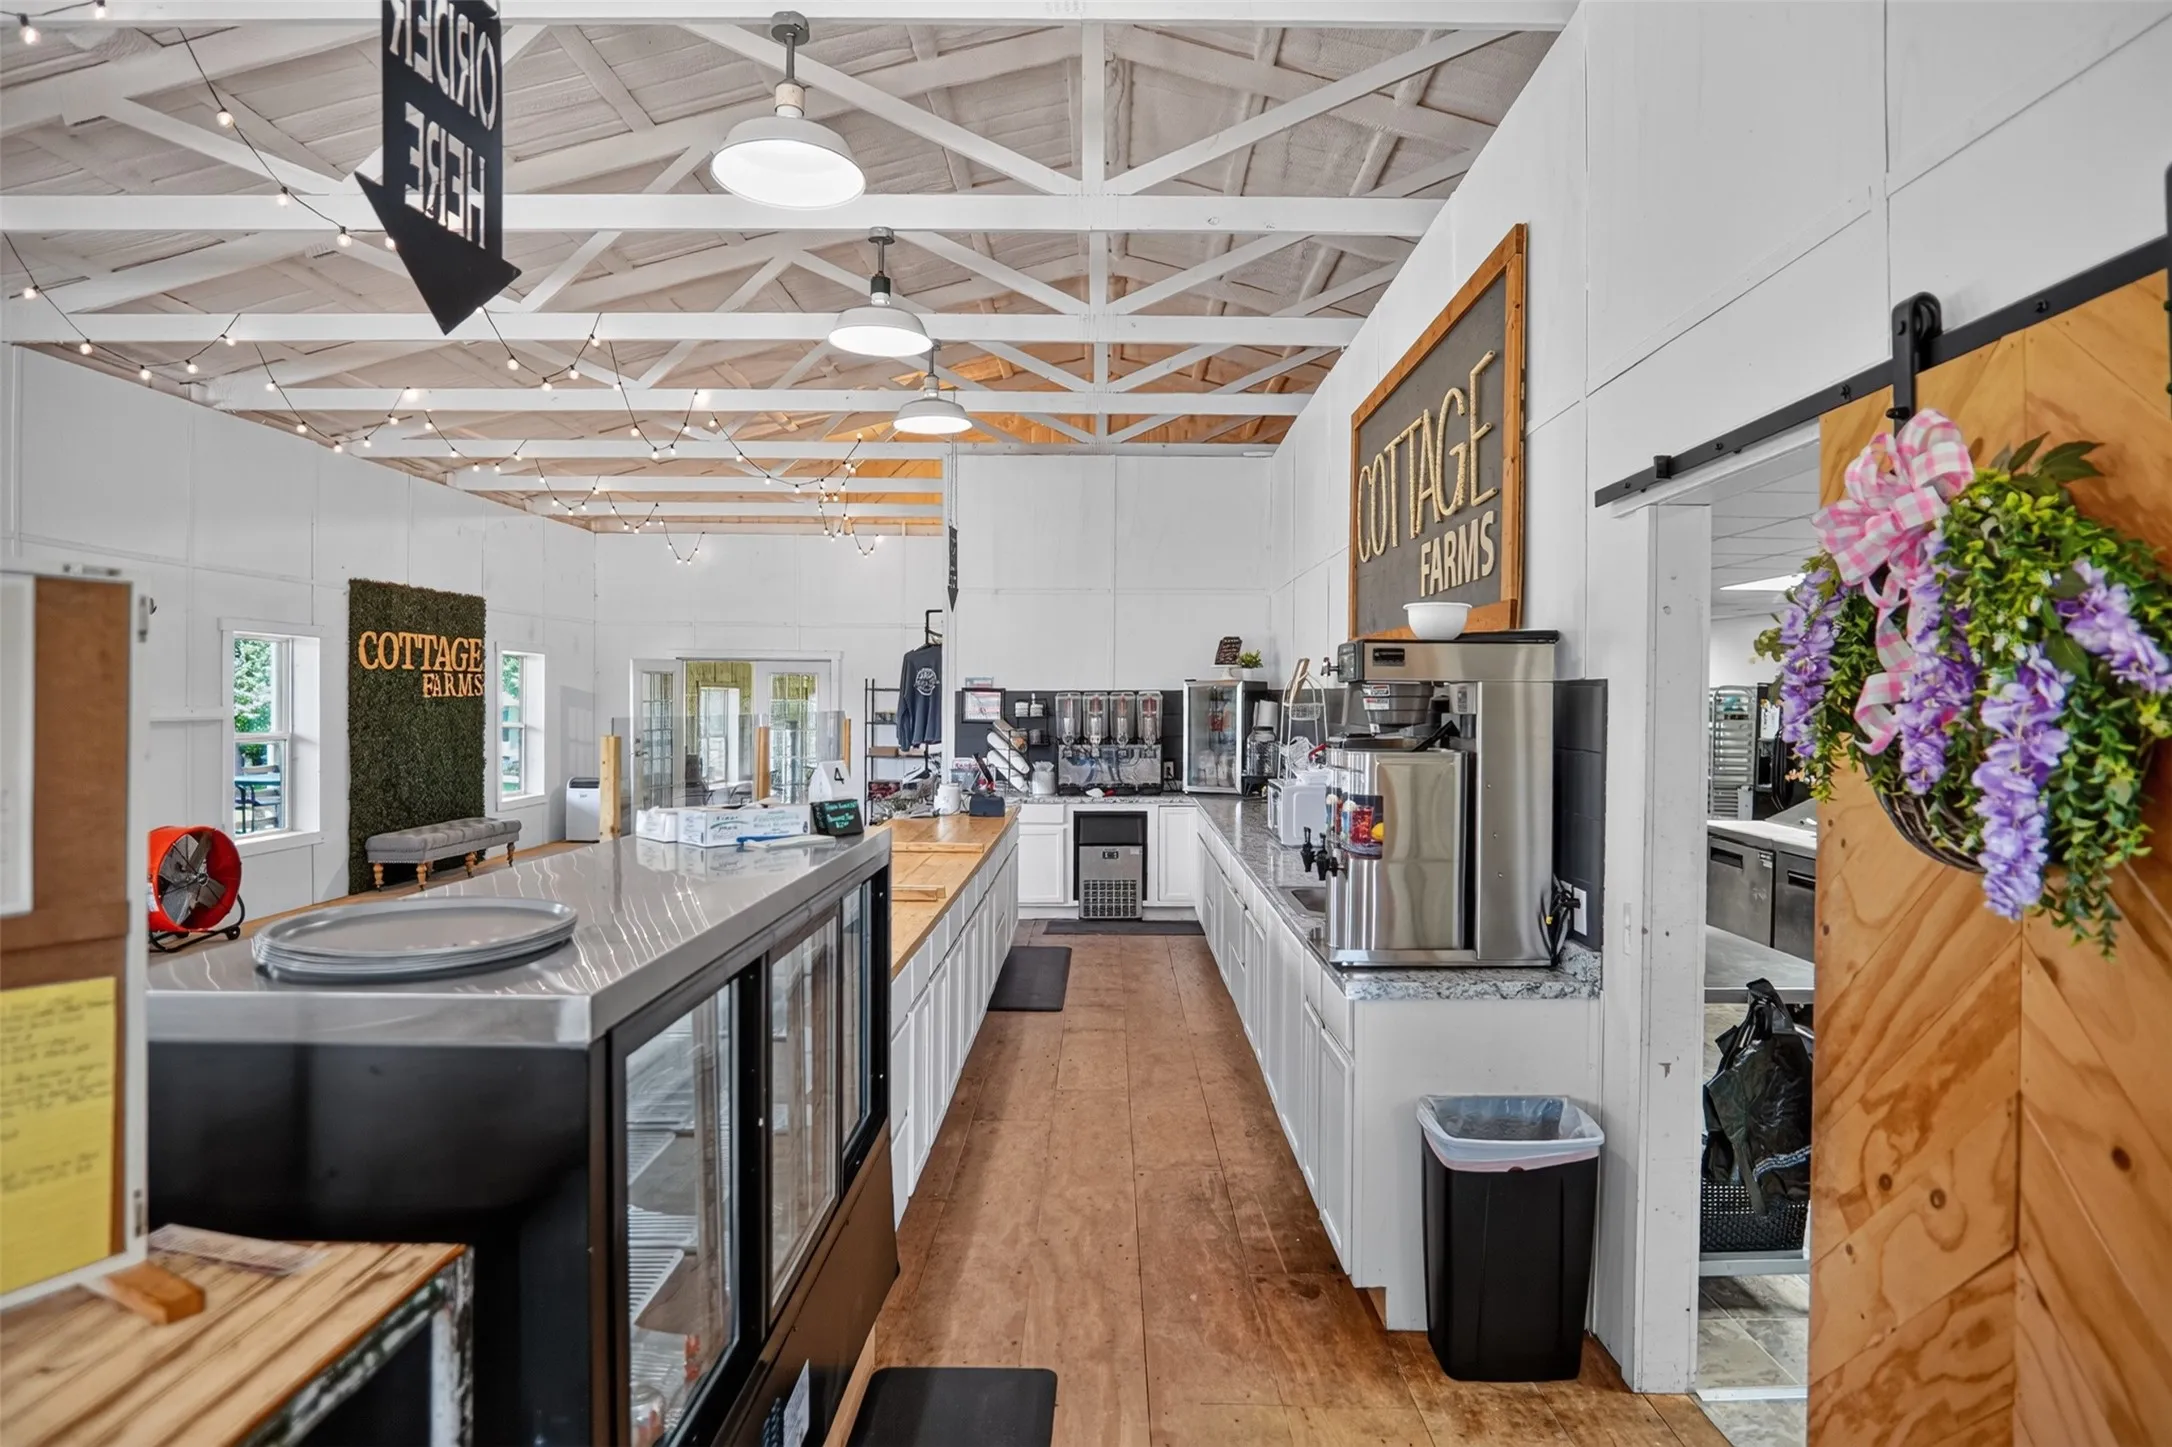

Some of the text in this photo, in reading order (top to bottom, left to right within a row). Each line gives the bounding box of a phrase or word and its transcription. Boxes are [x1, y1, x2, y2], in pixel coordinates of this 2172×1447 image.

[1357, 350, 1499, 563] COTTAGE
[1420, 510, 1495, 598] FARMS
[358, 630, 483, 672] COTTAGE
[422, 672, 484, 698] FARMS
[833, 767, 845, 785] 4
